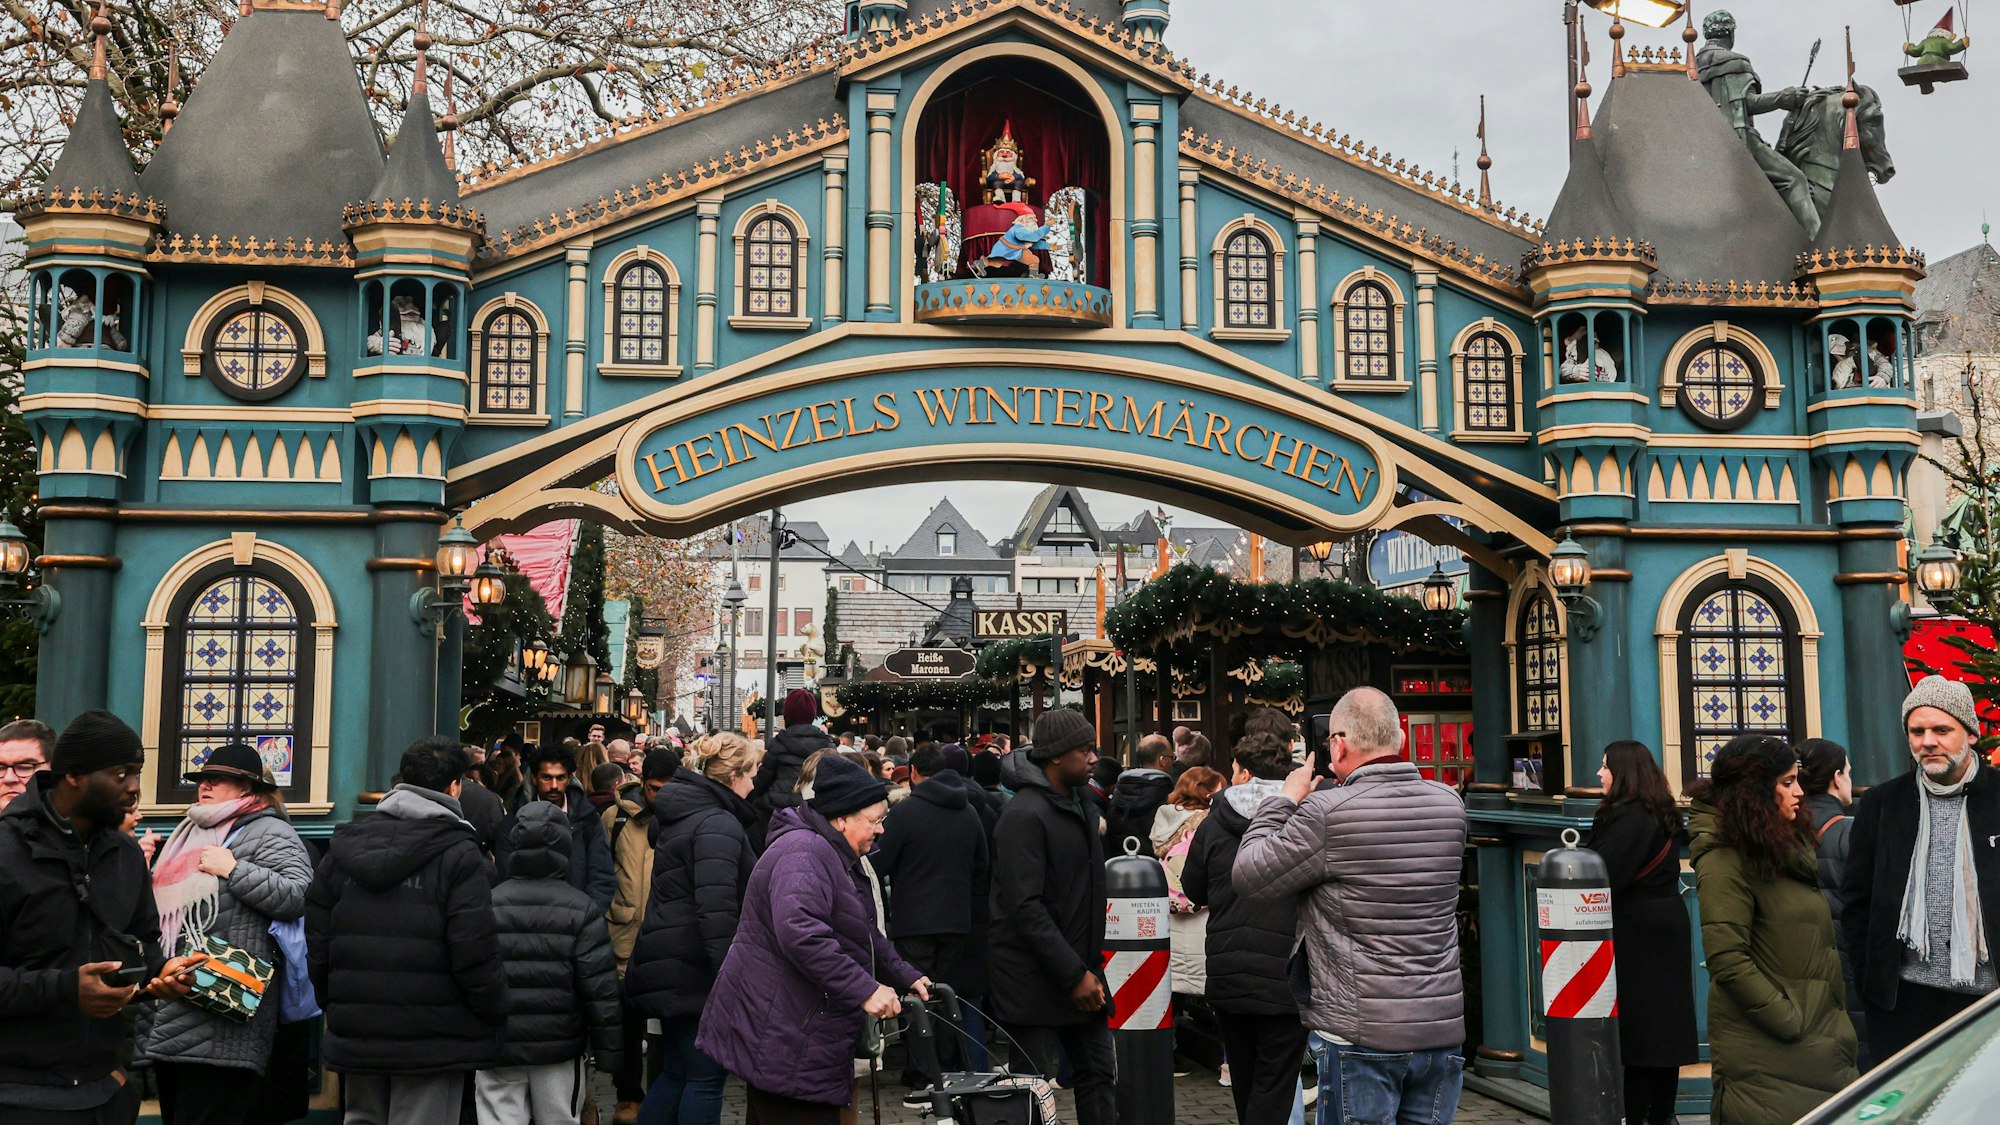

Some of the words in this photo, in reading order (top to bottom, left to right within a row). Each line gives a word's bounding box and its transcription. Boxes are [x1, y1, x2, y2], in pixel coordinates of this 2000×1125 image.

[641, 392, 901, 493] HEINZELS
[914, 386, 1374, 502] WINTERMÄRCHEN
[977, 612, 1062, 636] KASSE
[917, 652, 944, 663] Heiße
[911, 664, 950, 674] Maronen
